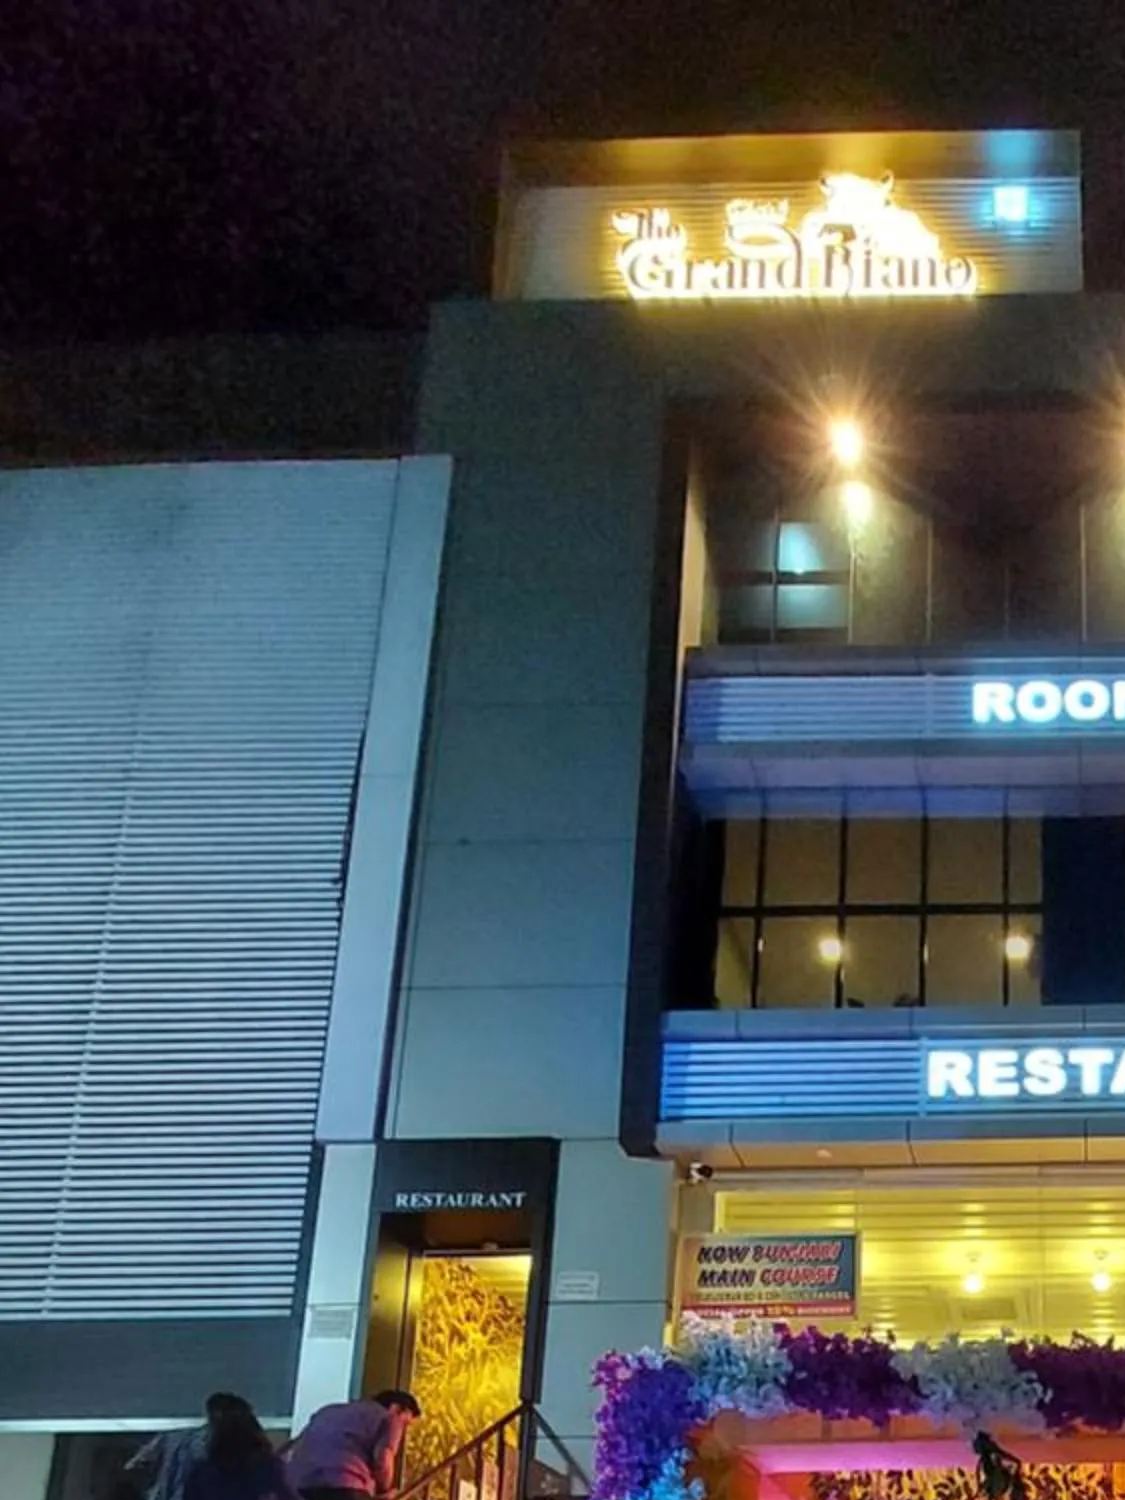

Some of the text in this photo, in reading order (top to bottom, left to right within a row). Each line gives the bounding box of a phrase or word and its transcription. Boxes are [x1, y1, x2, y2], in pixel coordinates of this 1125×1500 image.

[627, 222, 976, 296] Grand Piano
[395, 1191, 527, 1208] RESTAURANT
[697, 1265, 841, 1288] MAIN COURSE
